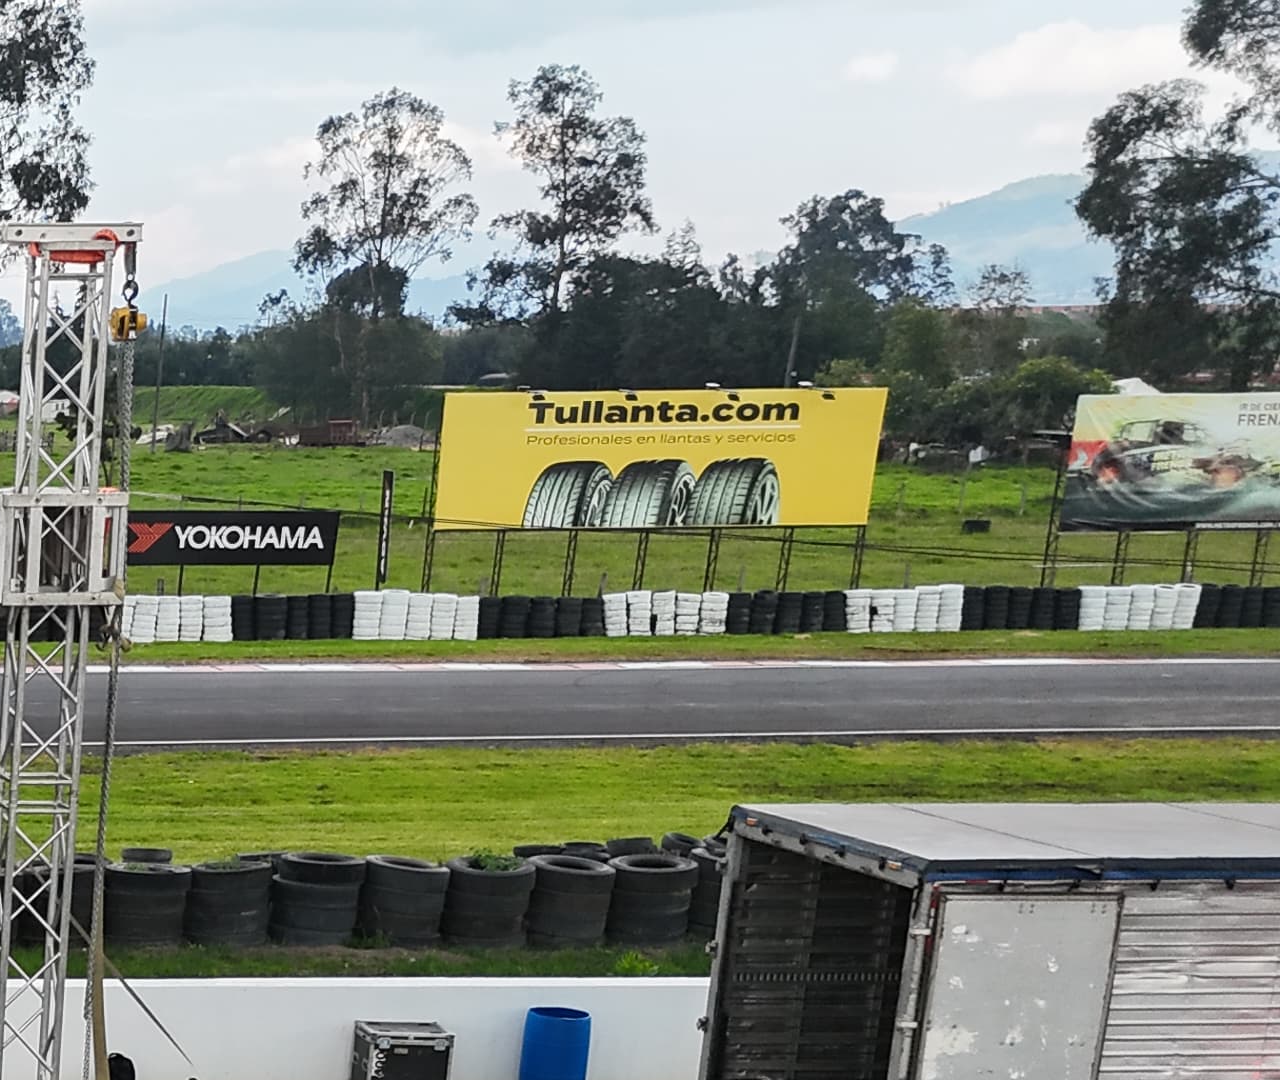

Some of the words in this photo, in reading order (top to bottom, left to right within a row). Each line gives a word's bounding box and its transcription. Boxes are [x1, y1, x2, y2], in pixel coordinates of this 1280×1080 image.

[528, 401, 800, 424] Tullanta.com
[1237, 413, 1280, 426] FREN
[526, 434, 632, 446] Profesionales
[636, 435, 656, 444] en
[660, 433, 710, 444] llantas
[715, 434, 723, 445] y
[727, 432, 796, 443] servicios
[175, 525, 324, 550] YOKOHAMA
